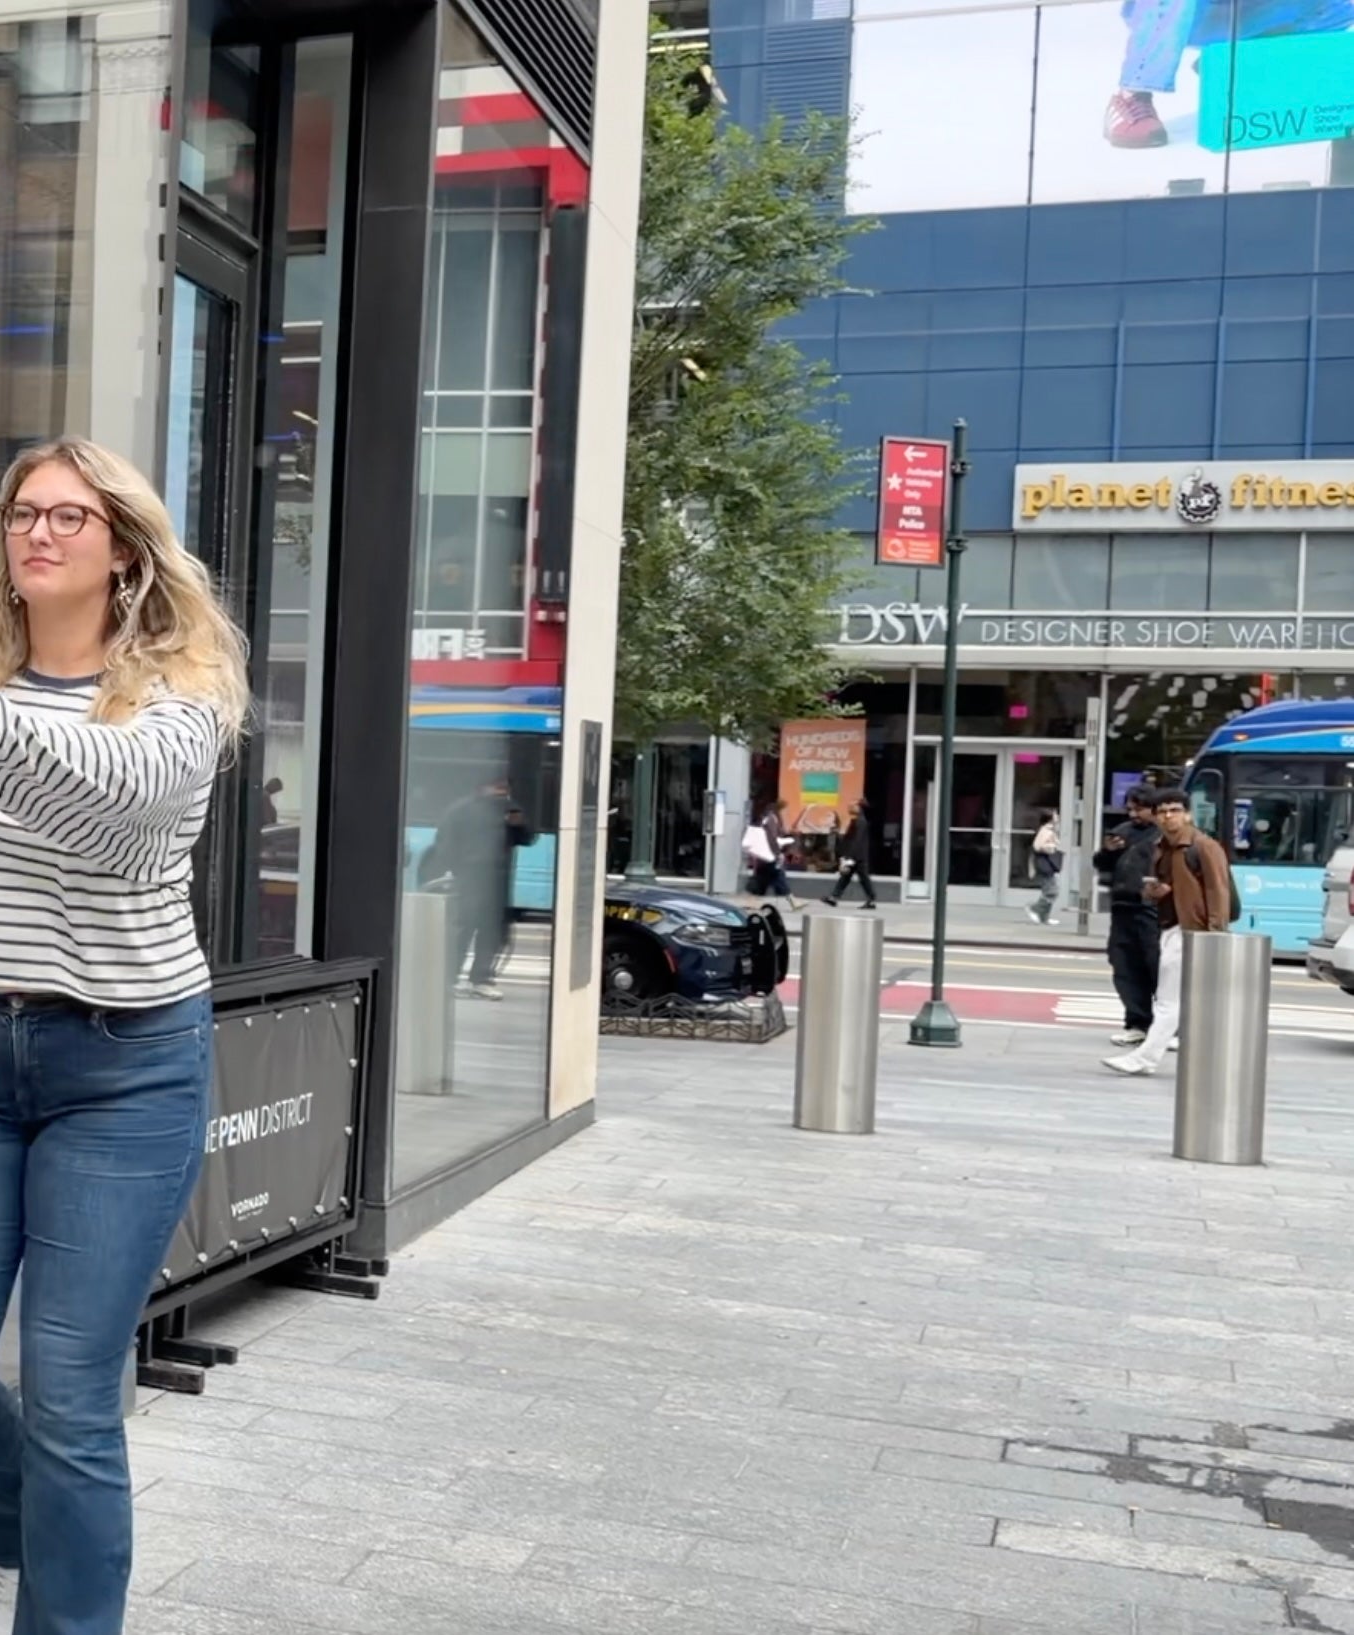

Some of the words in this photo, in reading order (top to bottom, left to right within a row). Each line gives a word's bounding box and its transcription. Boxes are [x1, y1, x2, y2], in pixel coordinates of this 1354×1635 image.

[1224, 107, 1308, 145] DSW
[1021, 474, 1173, 518] planet
[839, 602, 969, 644] DSW
[981, 620, 1125, 644] DESIGNER
[1136, 621, 1216, 644] SHOE
[786, 730, 863, 748] HUNDREDS
[795, 747, 815, 759] OF
[817, 747, 850, 760] NEW
[788, 759, 855, 772] ARRIVALS
[219, 1108, 259, 1149] PENN
[260, 1092, 314, 1137] DISTRICT
[231, 1191, 270, 1217] VORNADO
